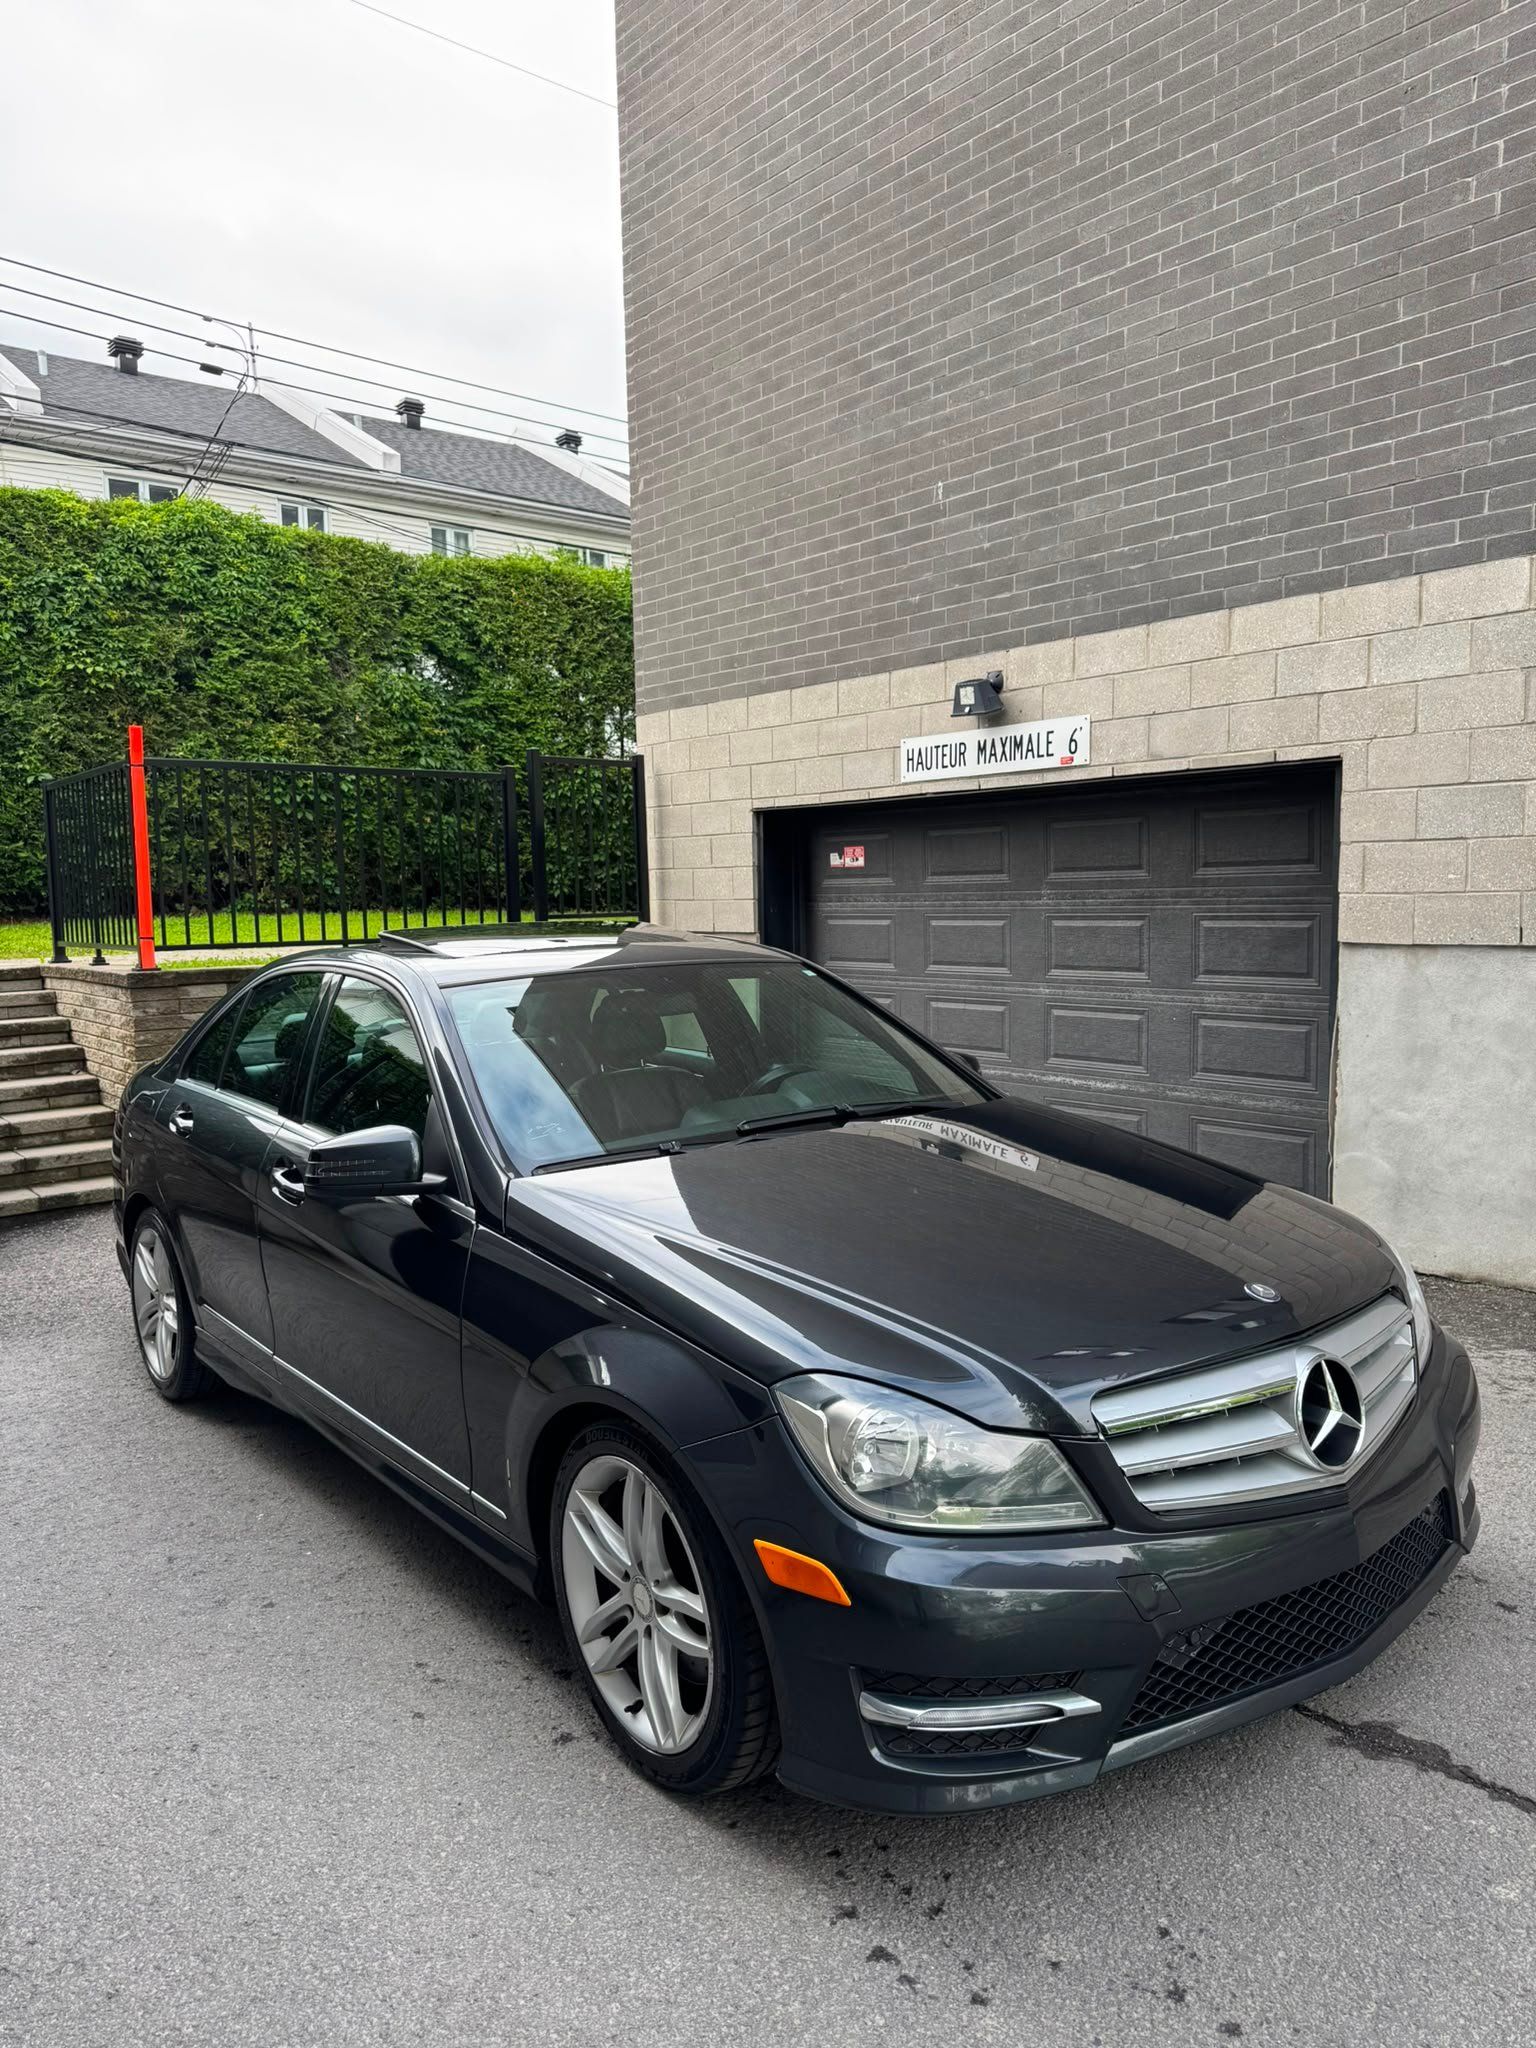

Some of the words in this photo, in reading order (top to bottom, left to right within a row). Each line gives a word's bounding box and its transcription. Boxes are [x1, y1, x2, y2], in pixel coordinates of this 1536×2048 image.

[906, 742, 967, 773] HAUTEUR
[977, 730, 1055, 765] MAXIMALE
[1068, 726, 1083, 755] 6'
